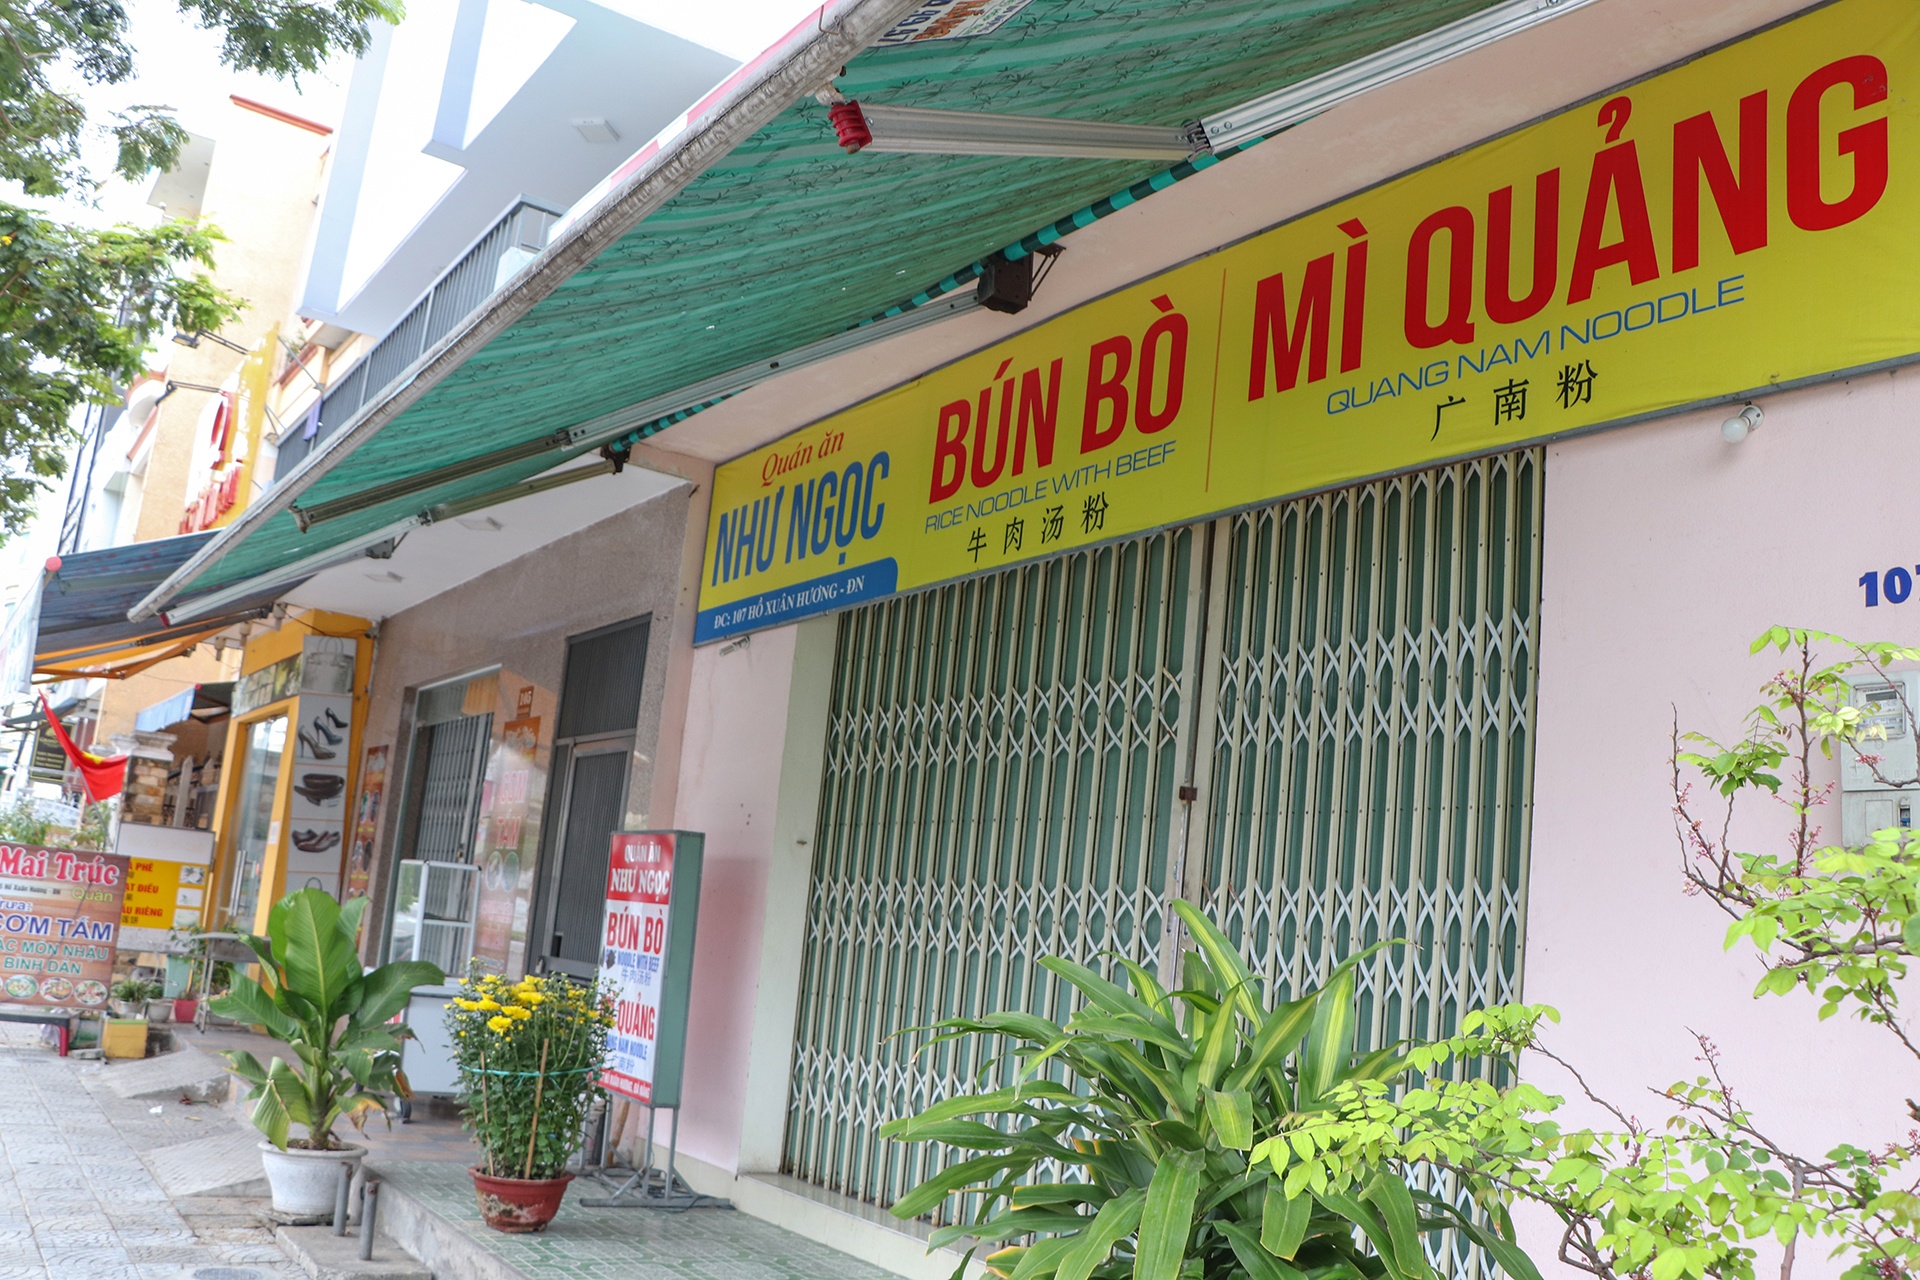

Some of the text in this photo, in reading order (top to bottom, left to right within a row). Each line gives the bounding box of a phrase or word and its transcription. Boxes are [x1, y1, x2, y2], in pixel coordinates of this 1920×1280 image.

[1247, 54, 1889, 402] MÌ QUẢNG
[1326, 274, 1746, 415] QUANG NAM NOODLE
[928, 294, 1189, 505] BÚN BÒ
[1430, 358, 1599, 442] 广南粉
[761, 429, 845, 487] Quán ăn
[925, 440, 1177, 534] RICE NOODLE WITH BEEF
[711, 451, 891, 588] NHƯ NGỌC
[967, 491, 1110, 564] 牛肉汤粉
[713, 614, 731, 629] ĐC:
[732, 611, 747, 624] 107
[748, 596, 764, 620] HỒ
[764, 592, 796, 616] XUÂN
[796, 583, 838, 608] HƯƠNG
[846, 575, 865, 595] ĐN
[1859, 565, 1920, 607] 10
[0, 846, 118, 885] Mai Trúc
[610, 865, 670, 902] NHƯ NGỌC
[0, 914, 112, 942] ƠM TẤM
[606, 906, 664, 955] BÚN BÒ
[617, 991, 656, 1042] QUẢNG
